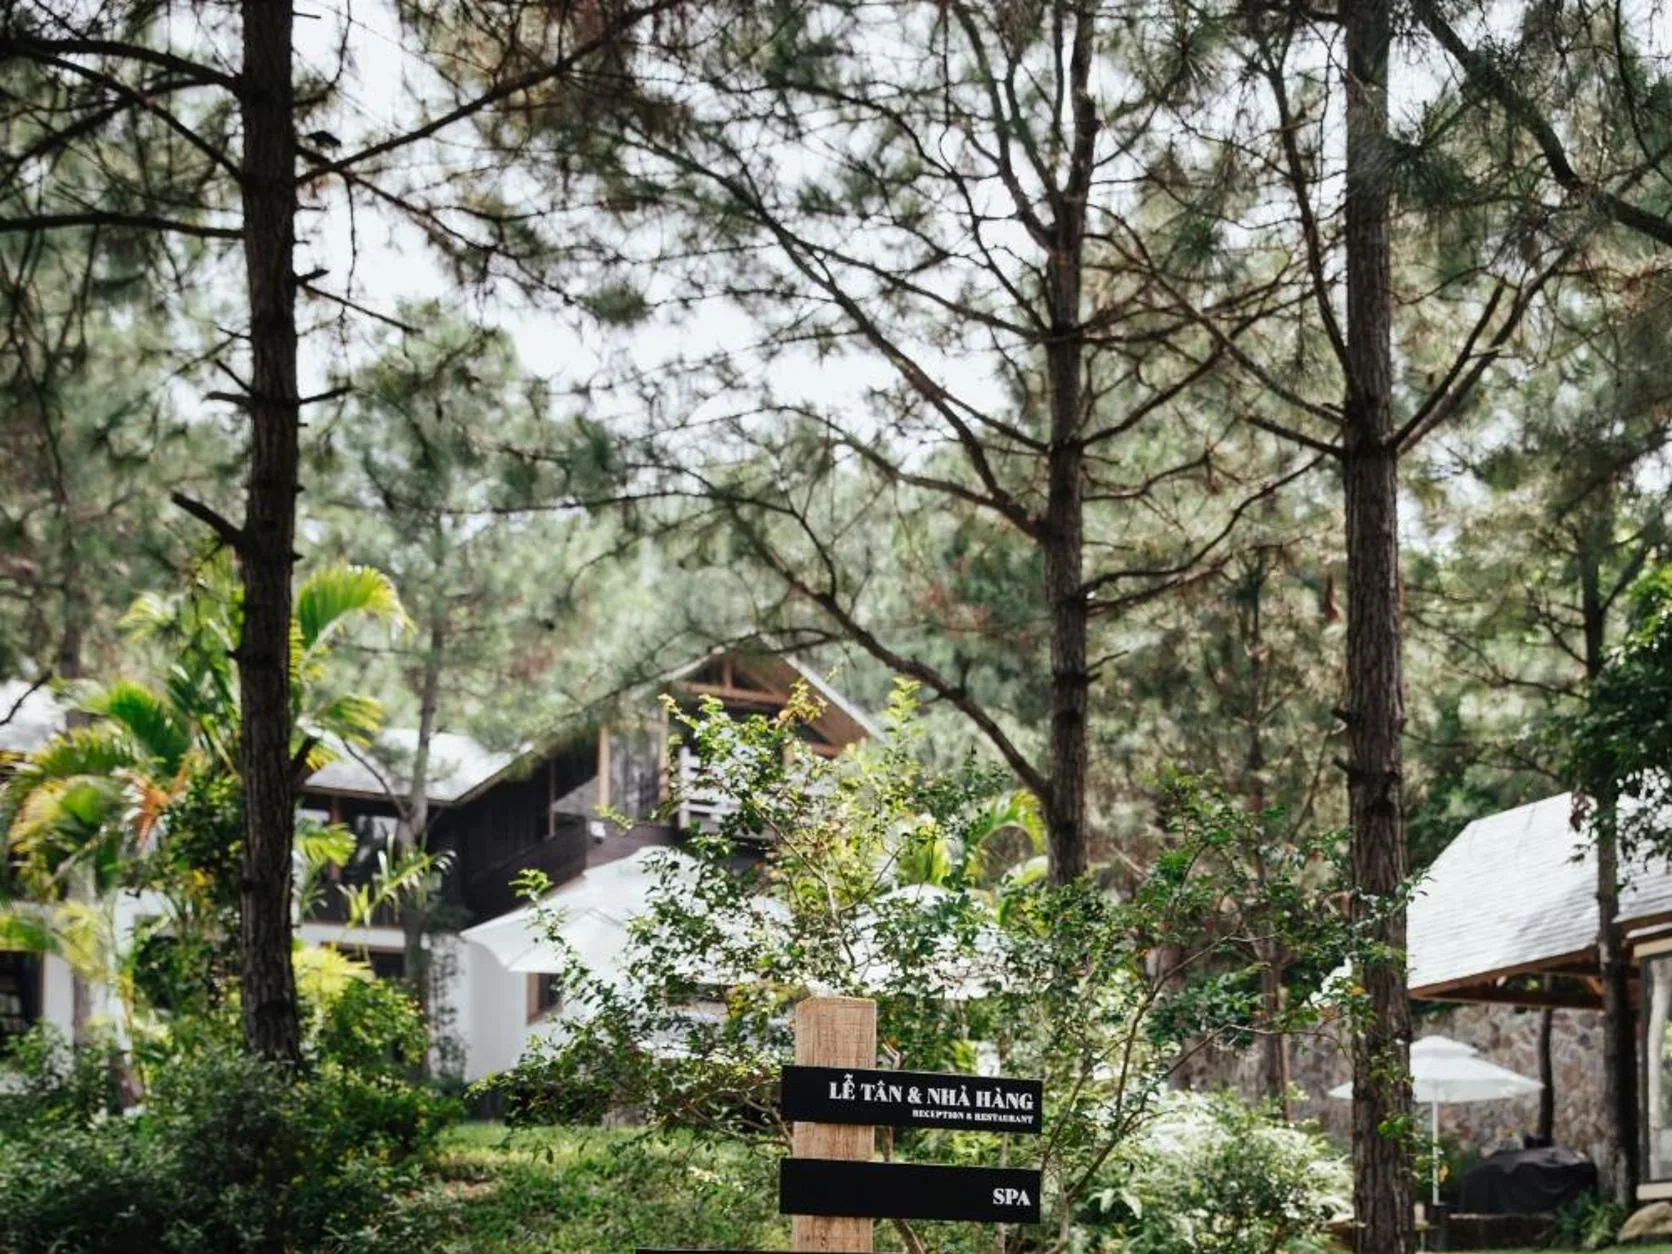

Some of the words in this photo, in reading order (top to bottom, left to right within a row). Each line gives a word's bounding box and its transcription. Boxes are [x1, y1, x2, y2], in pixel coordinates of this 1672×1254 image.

[829, 1074, 855, 1100] LỄ
[860, 1080, 902, 1103] TÂN
[907, 1087, 922, 1104] &
[927, 1085, 970, 1107] NHÀ
[976, 1088, 1034, 1110] HÀNG
[912, 1109, 964, 1120] RECEPTION
[975, 1113, 1034, 1125] RESTAURANT
[992, 1188, 1031, 1206] SPA
